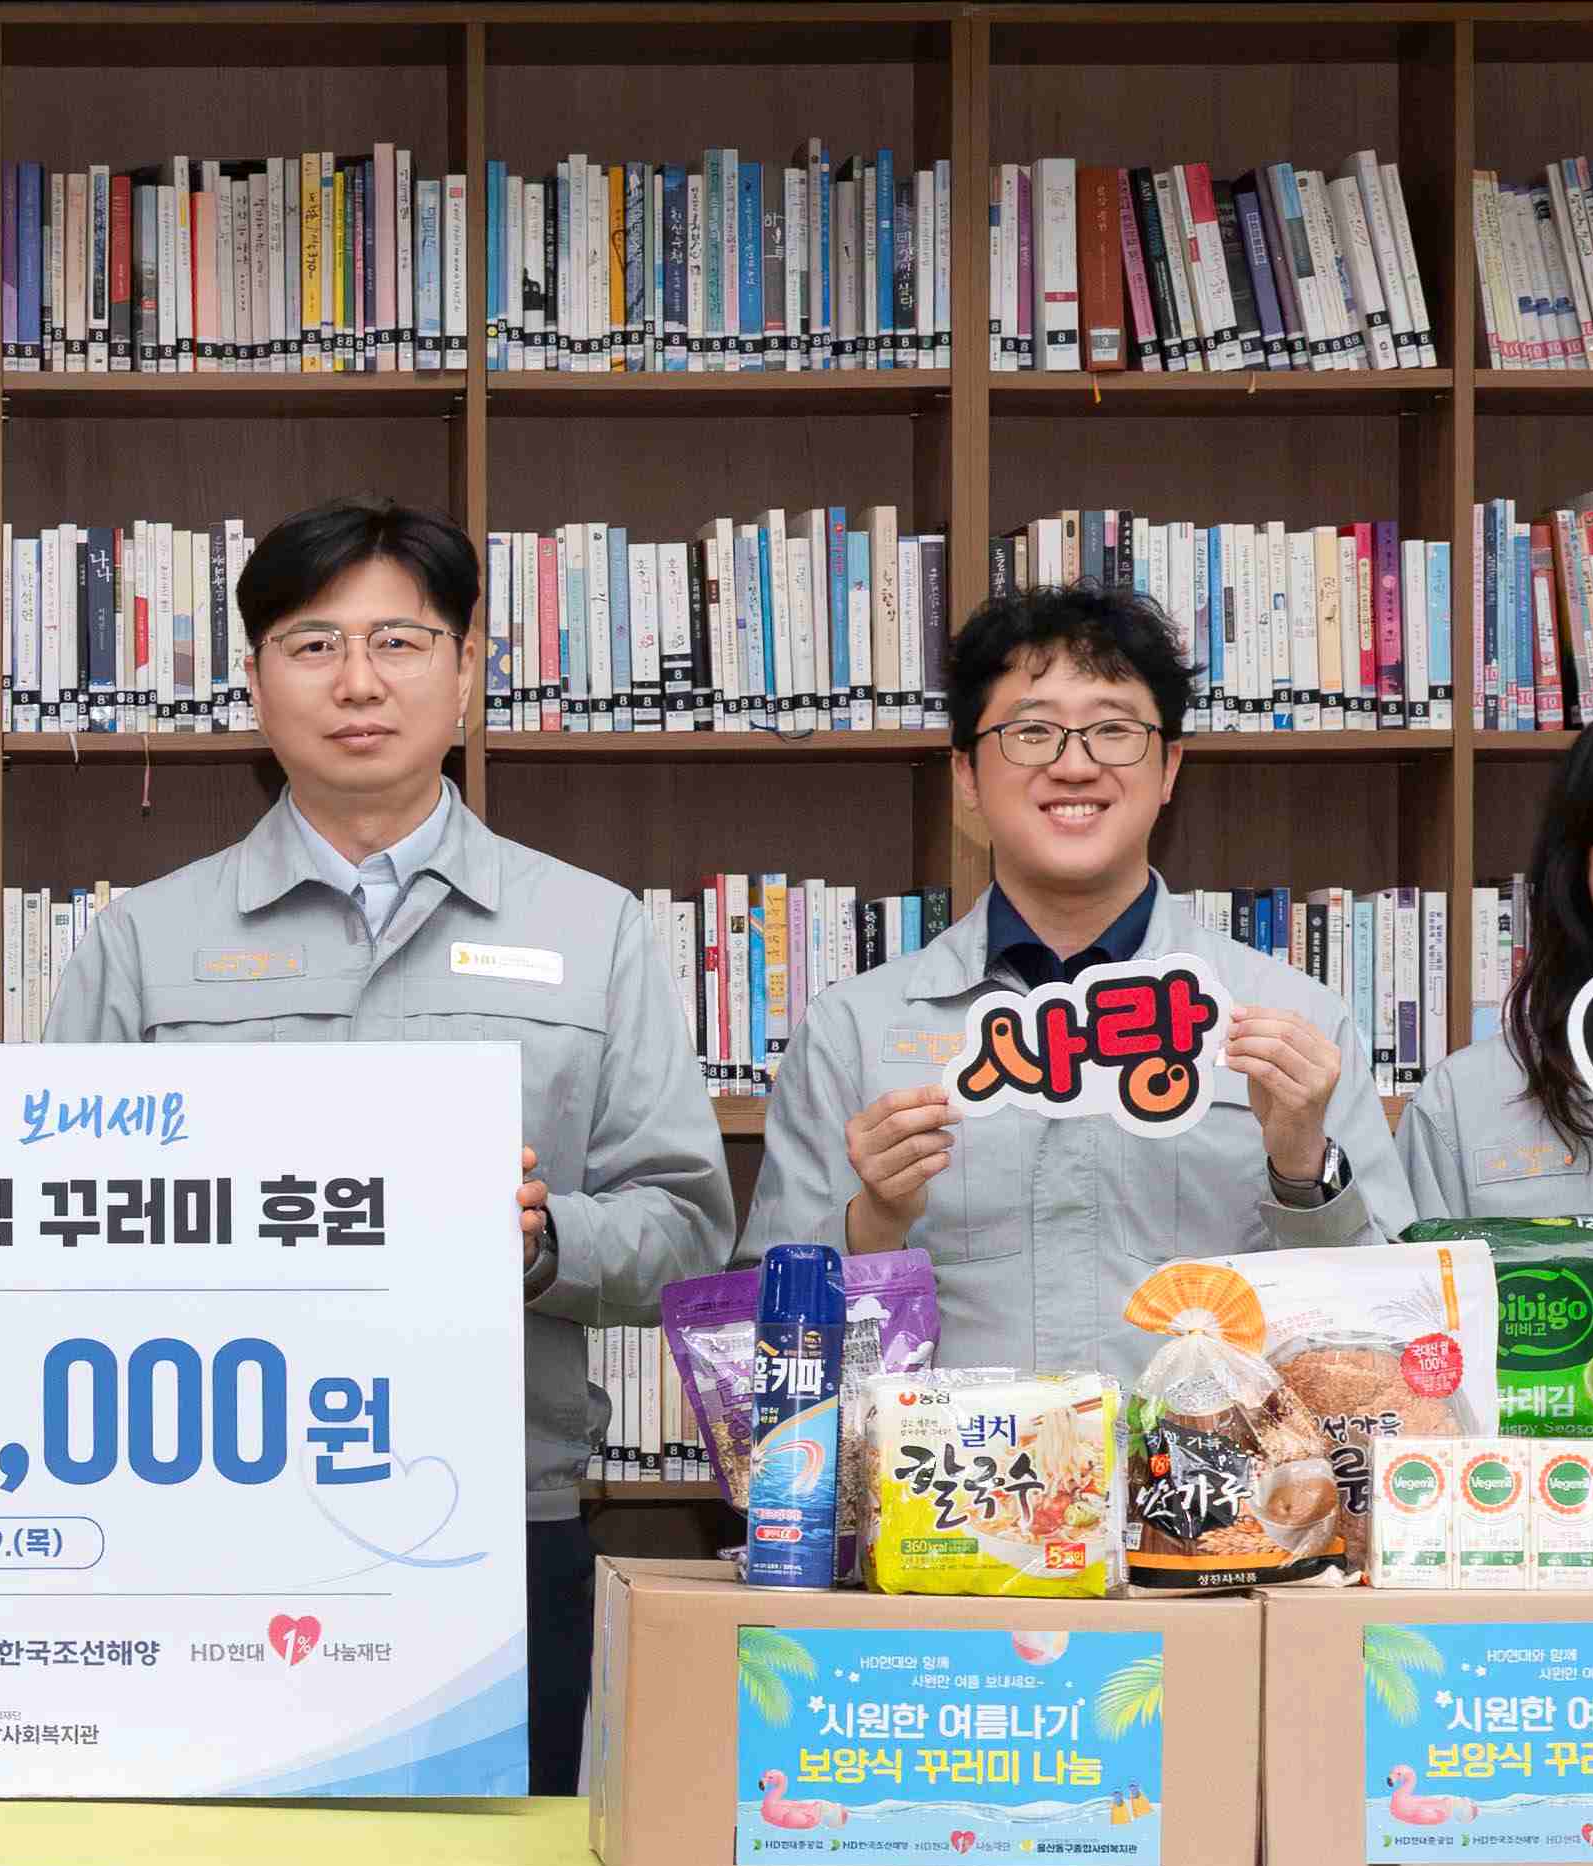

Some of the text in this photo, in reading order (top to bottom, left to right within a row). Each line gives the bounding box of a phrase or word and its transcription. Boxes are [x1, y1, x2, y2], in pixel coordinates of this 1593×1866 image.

[958, 972, 1223, 1122] 사랑
[18, 1089, 191, 1147] 보내세요
[39, 1177, 233, 1246] 꾸러미
[258, 1176, 386, 1247] 후원
[1505, 1322, 1548, 1338] 비비고
[957, 1413, 1018, 1448] 멸치
[894, 1443, 1046, 1530] 칼국수
[1393, 1474, 1434, 1491] Vegemil
[1470, 1474, 1513, 1491] Vegemil
[1548, 1474, 1589, 1491] Vegemil
[190, 1641, 265, 1664] HD현대
[322, 1641, 393, 1663] 나눔재단
